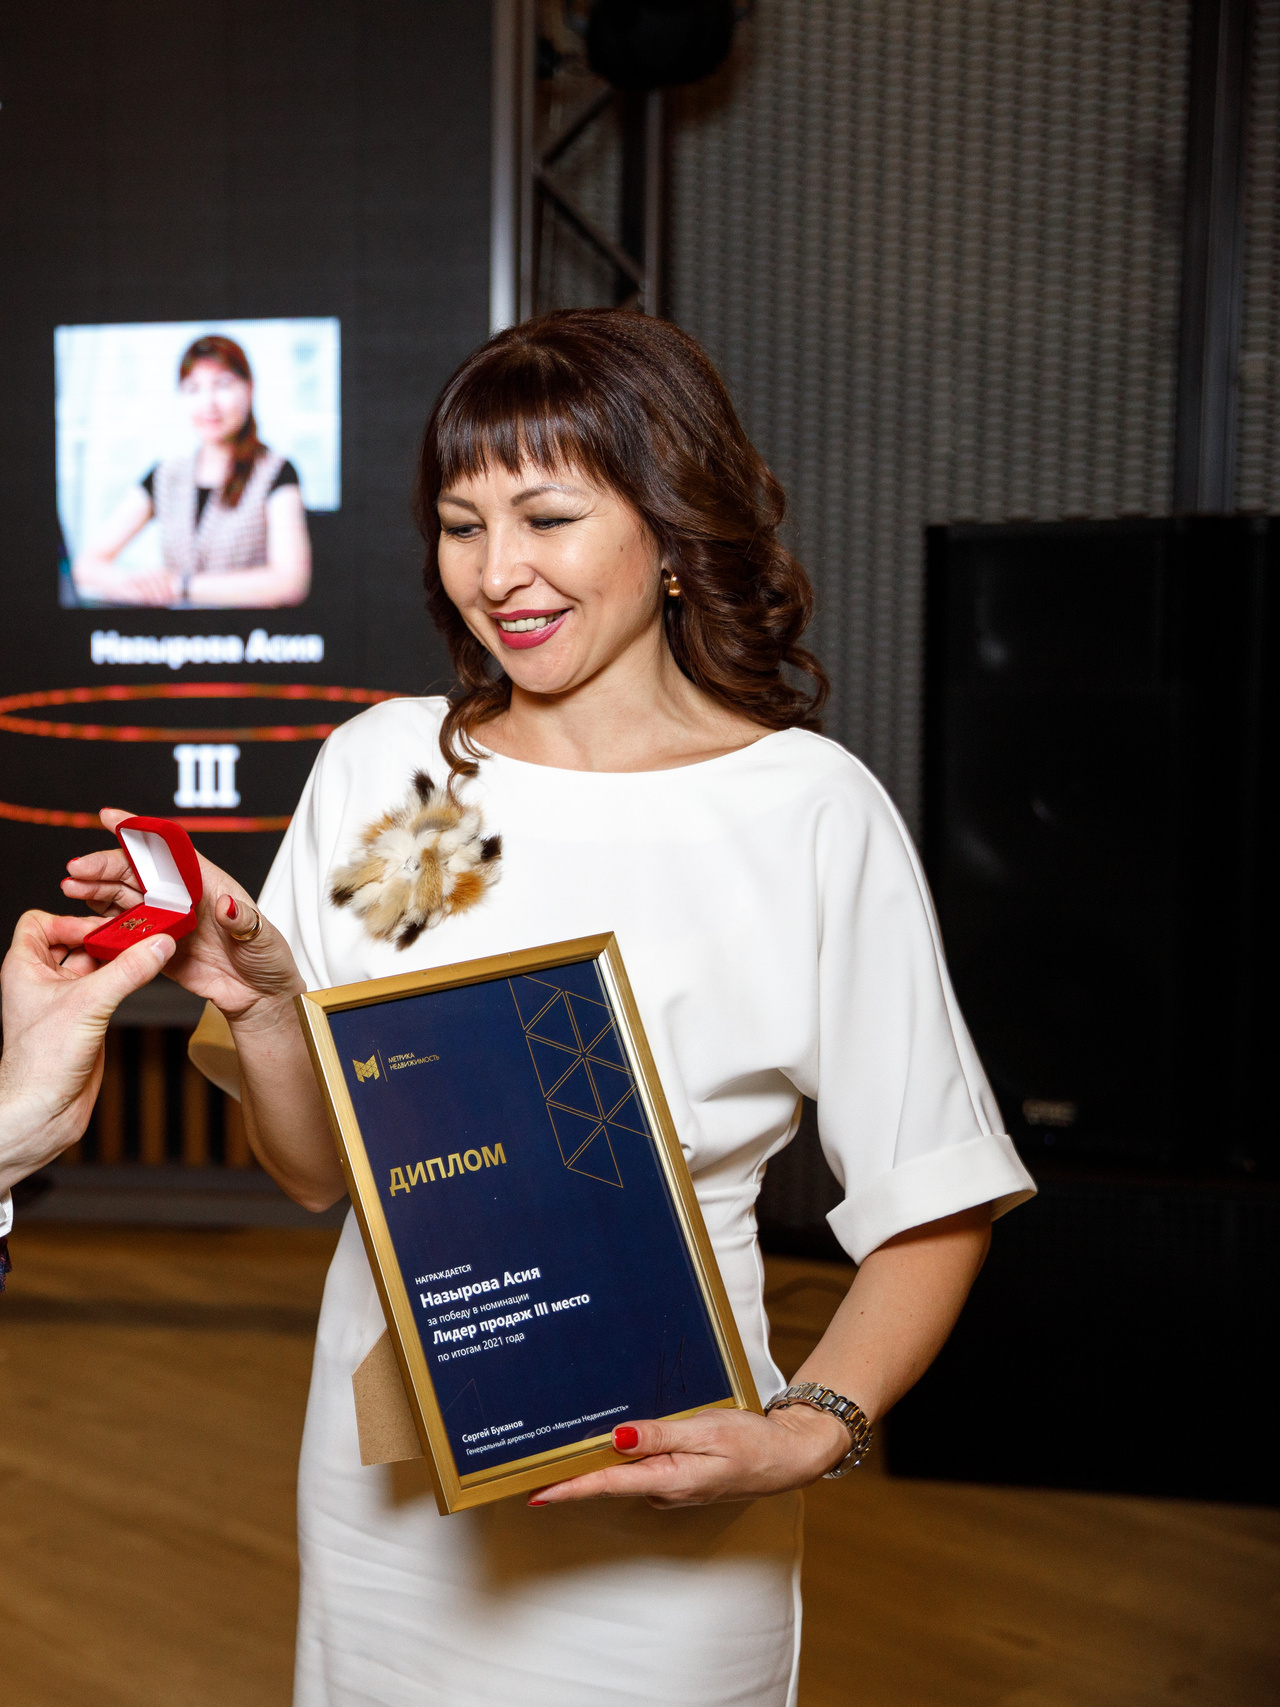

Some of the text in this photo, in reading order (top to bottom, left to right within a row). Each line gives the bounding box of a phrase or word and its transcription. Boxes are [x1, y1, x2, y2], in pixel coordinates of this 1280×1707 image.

[173, 743, 241, 808] III
[388, 1052, 415, 1063] МЕТРИКА
[389, 1054, 440, 1070] НЕДВИЖИМОСТЬ
[389, 1142, 507, 1197] ДИПЛОМ
[415, 1264, 472, 1285] НАГРАЖДАЕТСЯ
[420, 1267, 541, 1308] Назырова Асия
[427, 1292, 530, 1326] за победу в номинации
[433, 1293, 591, 1344] Лидер продаж III место
[437, 1331, 526, 1363] по итогам 2021 года
[462, 1419, 524, 1443] Сергей Буканов
[466, 1404, 629, 1456] Генеральный директор ООО «Метрика Недвижимость»
